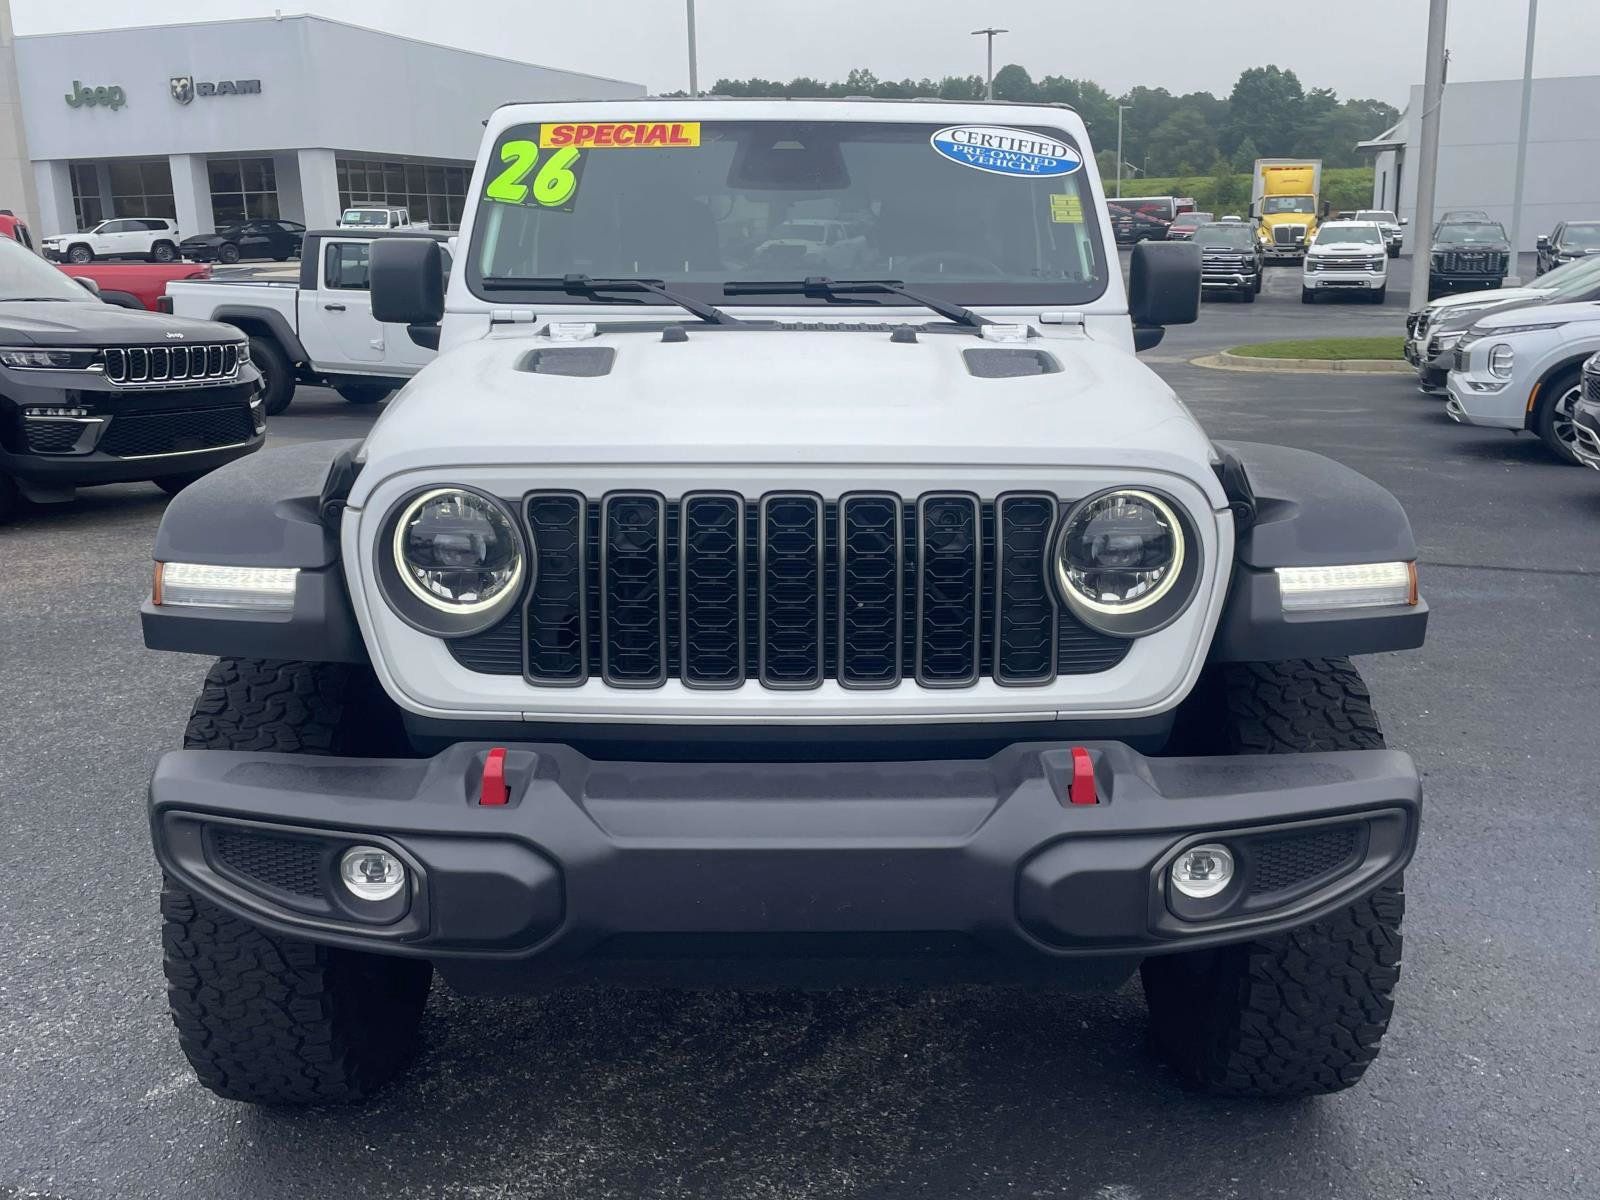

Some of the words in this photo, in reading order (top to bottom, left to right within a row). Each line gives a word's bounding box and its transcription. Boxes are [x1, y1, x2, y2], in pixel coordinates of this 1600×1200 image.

[64, 80, 127, 111] Jeep
[196, 80, 261, 97] RAM
[550, 124, 692, 147] SPECIAL
[951, 129, 1067, 158] CERTIFIED
[953, 145, 1057, 167] PRE-OWNED
[966, 154, 1041, 173] VEHICLE
[486, 140, 581, 207] 26
